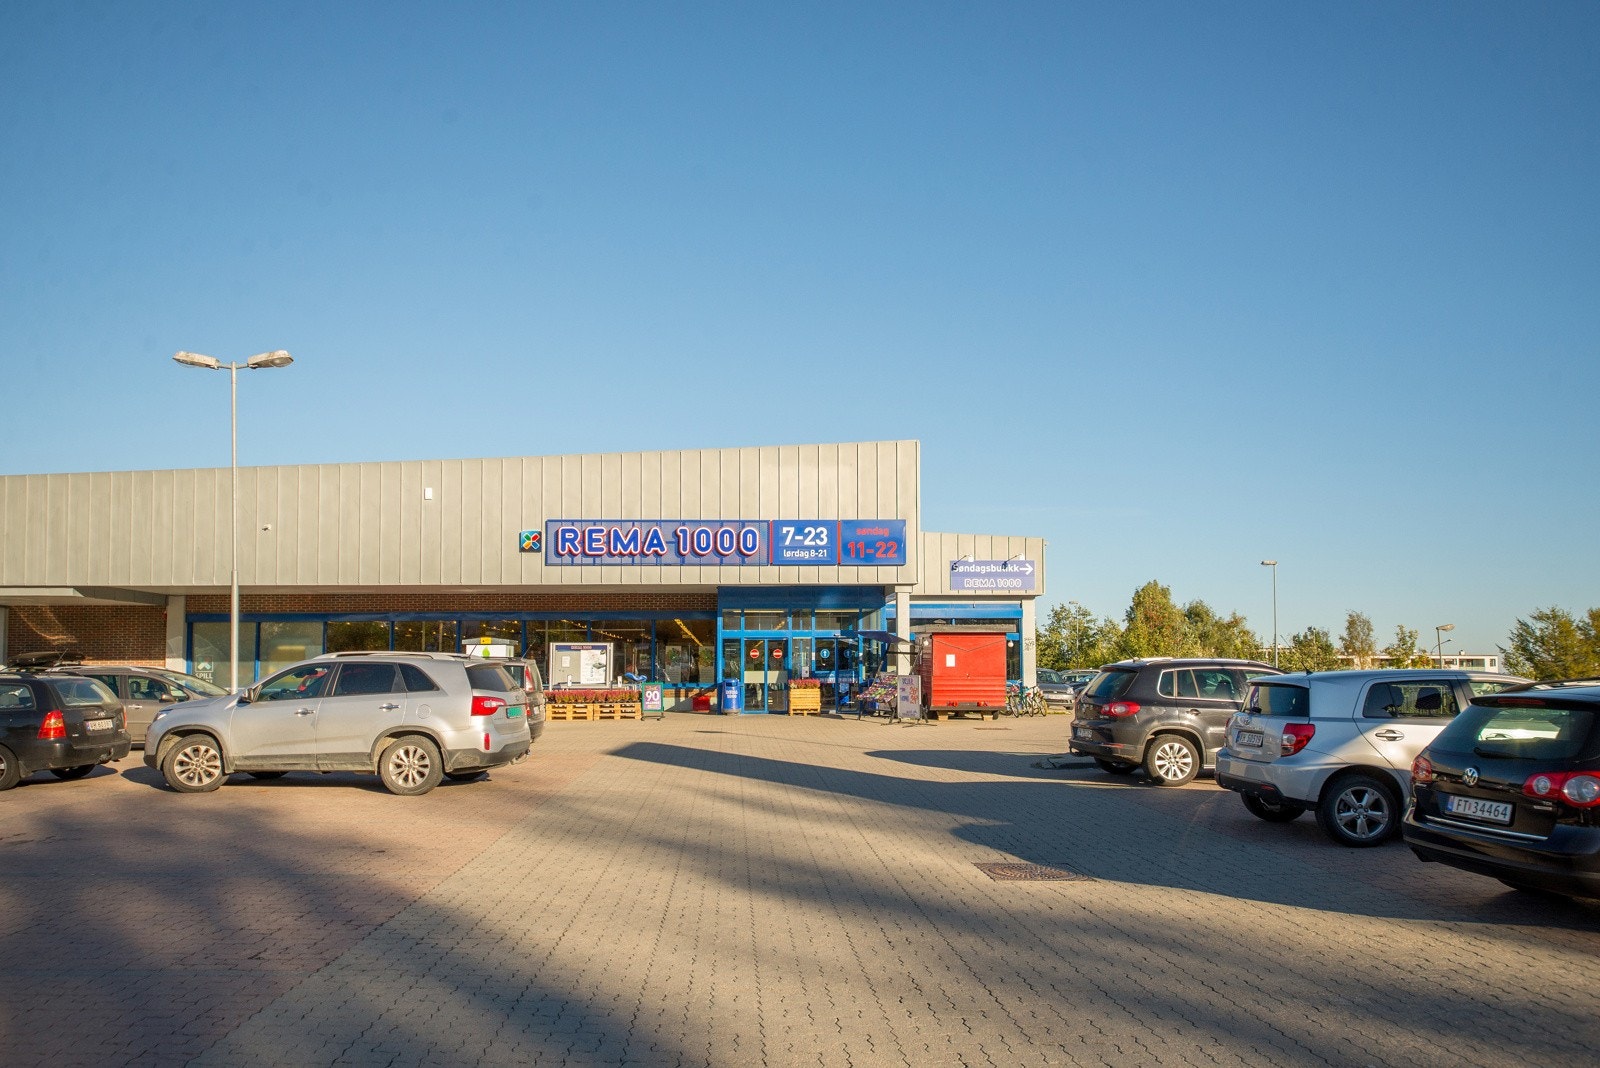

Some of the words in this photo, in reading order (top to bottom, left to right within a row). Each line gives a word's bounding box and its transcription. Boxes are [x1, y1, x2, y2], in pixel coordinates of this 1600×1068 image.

[781, 526, 828, 546] 7-23
[856, 526, 890, 537] søndag
[557, 526, 667, 556] REMA
[675, 526, 760, 556] 1000
[783, 549, 810, 559] lørdag
[810, 549, 828, 558] 8-21
[847, 541, 898, 559] 11-22
[964, 578, 996, 588] REMA
[997, 578, 1022, 588] 1000
[645, 690, 660, 701] 90
[1456, 798, 1469, 812] FT
[1472, 800, 1509, 819] 34464
